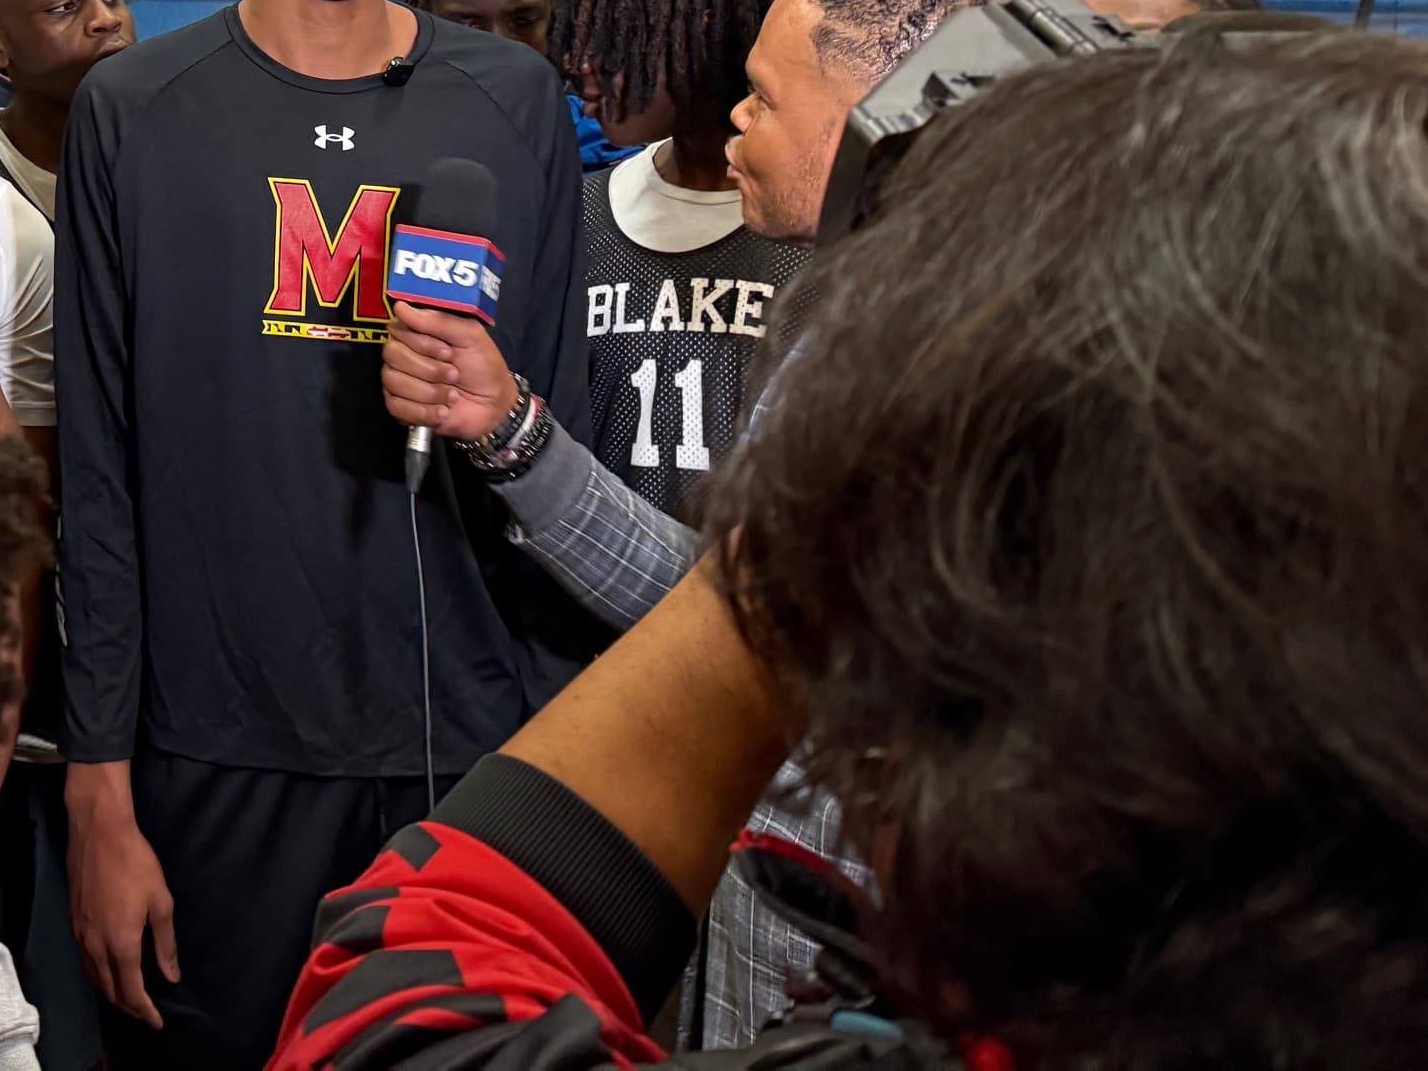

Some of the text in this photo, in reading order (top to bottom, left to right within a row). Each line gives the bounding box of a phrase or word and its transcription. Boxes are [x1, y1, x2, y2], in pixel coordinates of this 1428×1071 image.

[263, 176, 402, 324] M
[586, 276, 775, 339] BLAKE
[630, 358, 711, 471] 11
